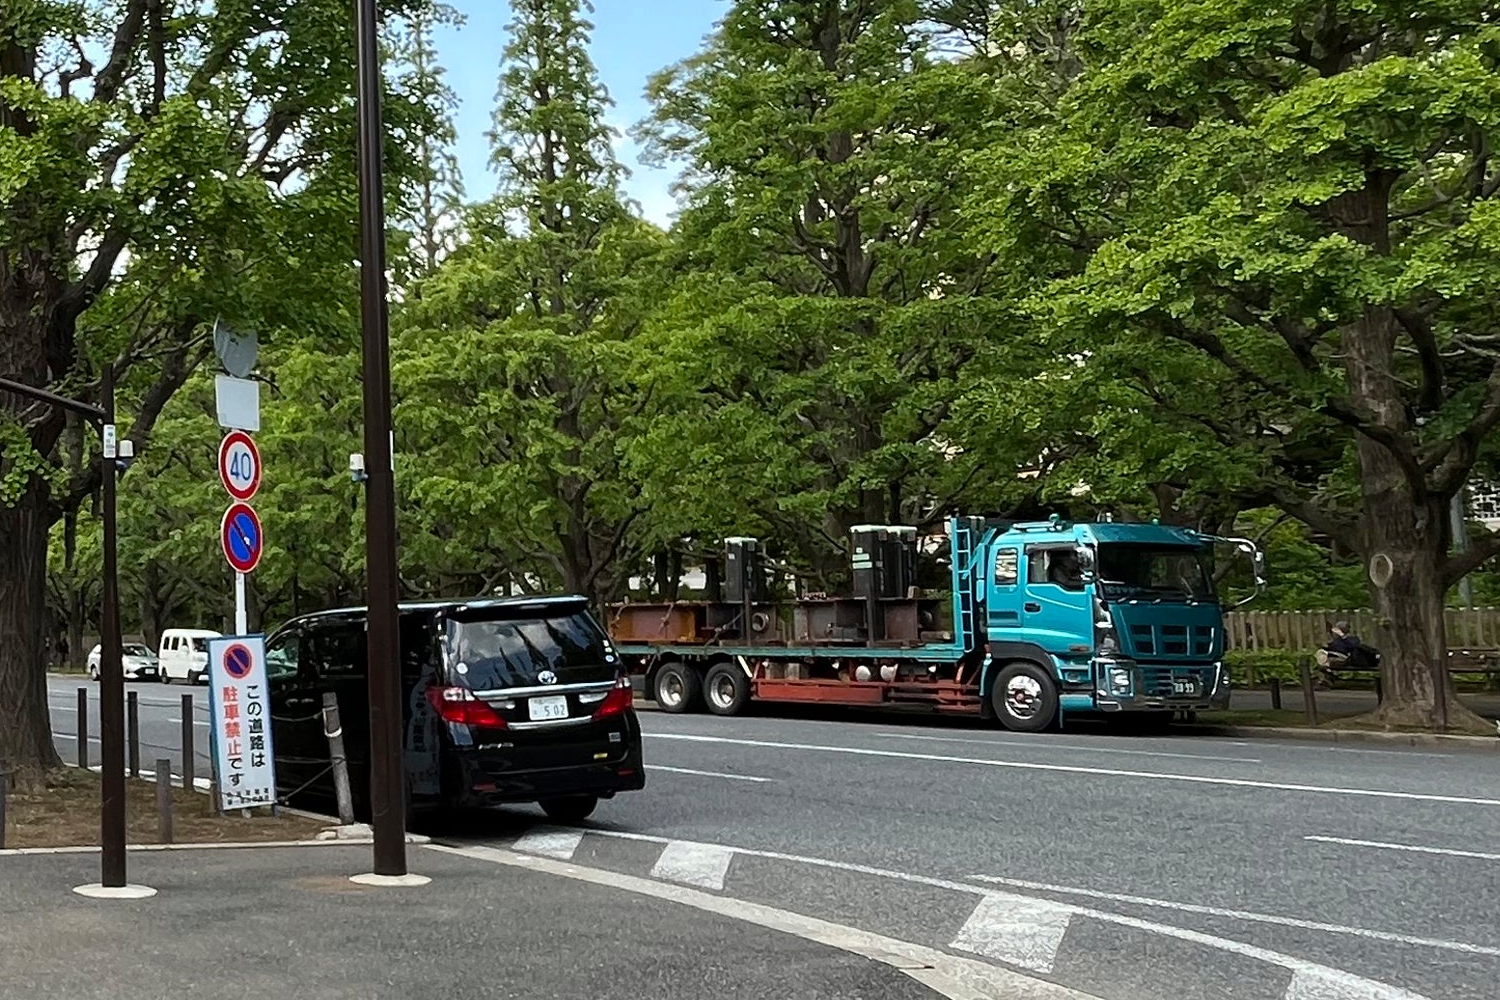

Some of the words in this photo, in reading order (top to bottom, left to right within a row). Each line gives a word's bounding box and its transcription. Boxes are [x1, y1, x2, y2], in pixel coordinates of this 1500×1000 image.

[230, 451, 252, 481] 40
[222, 686, 245, 787] 駐車禁止です
[246, 684, 266, 768] この道路は
